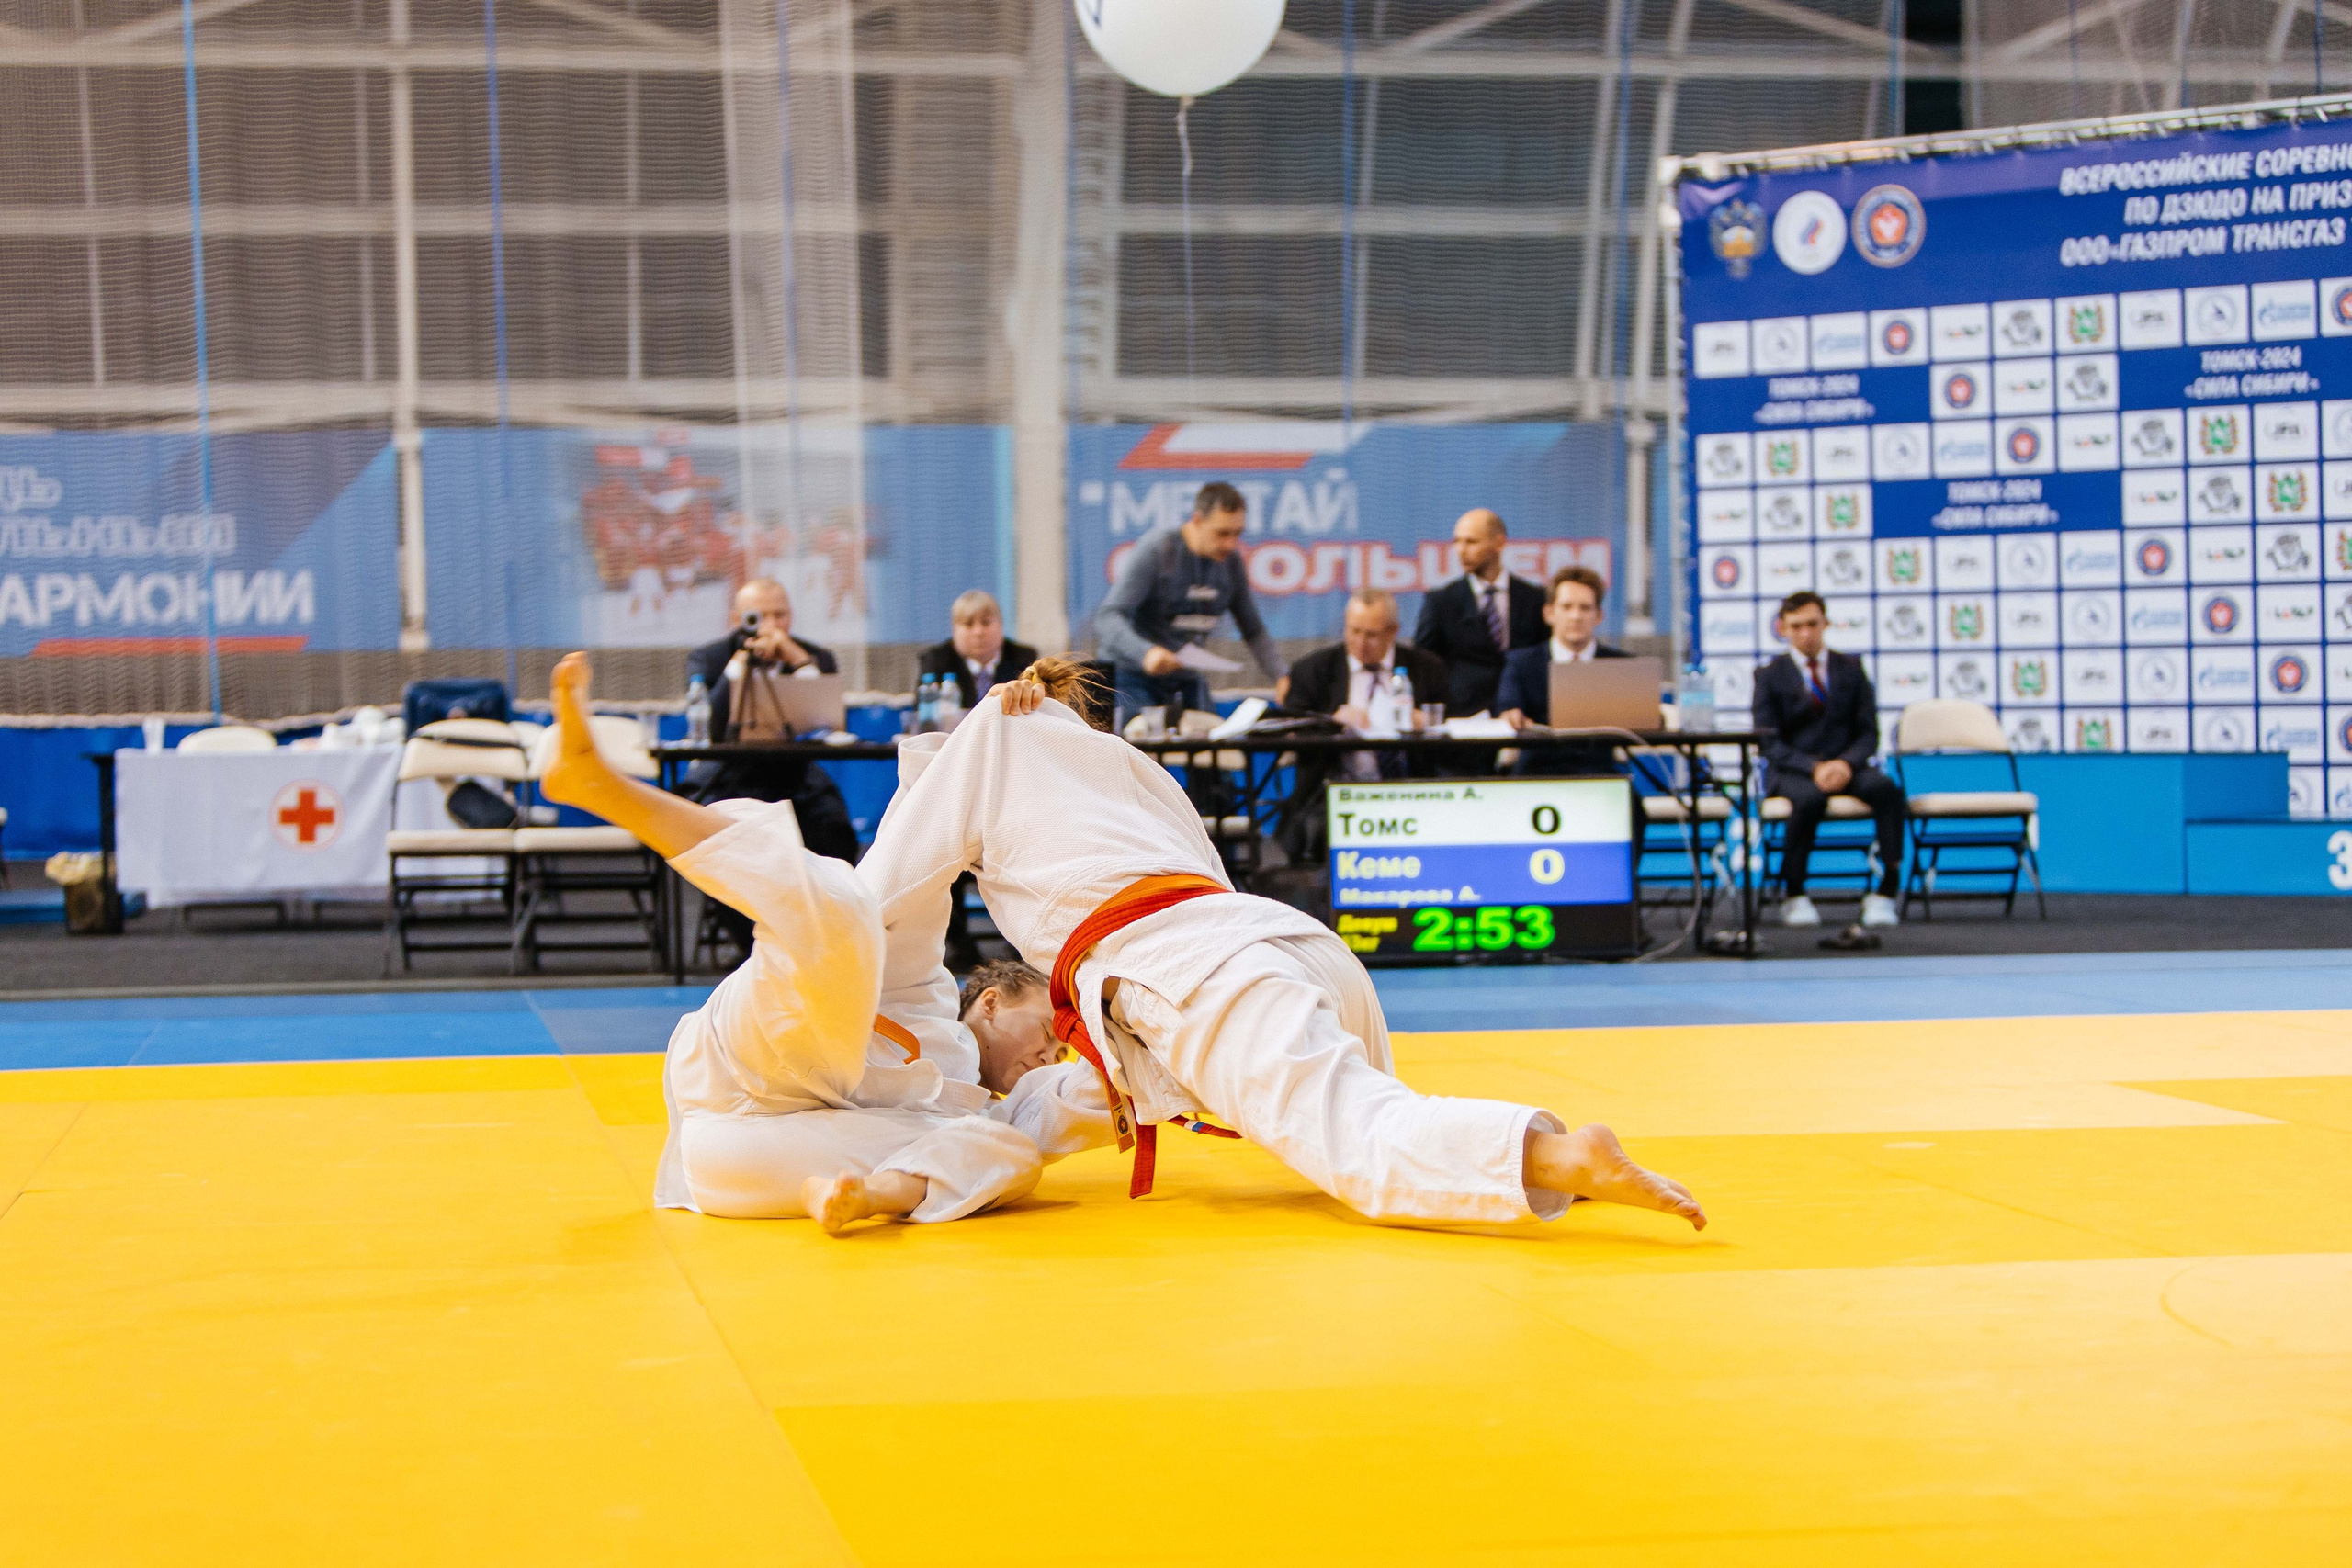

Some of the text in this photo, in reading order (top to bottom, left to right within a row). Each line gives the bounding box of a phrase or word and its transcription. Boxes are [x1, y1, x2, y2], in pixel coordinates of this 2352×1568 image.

[2059, 151, 2251, 196] ВСЕРОССИЙСКИЕ
[2123, 196, 2158, 225] ПО
[2160, 187, 2247, 225] ДЗЮДО
[2251, 185, 2284, 215] НА
[2232, 217, 2346, 253] ТРАНСГАЗ
[1337, 812, 1418, 837] Томс
[2327, 830, 2352, 890] 3
[1412, 905, 1555, 952] 2:53
